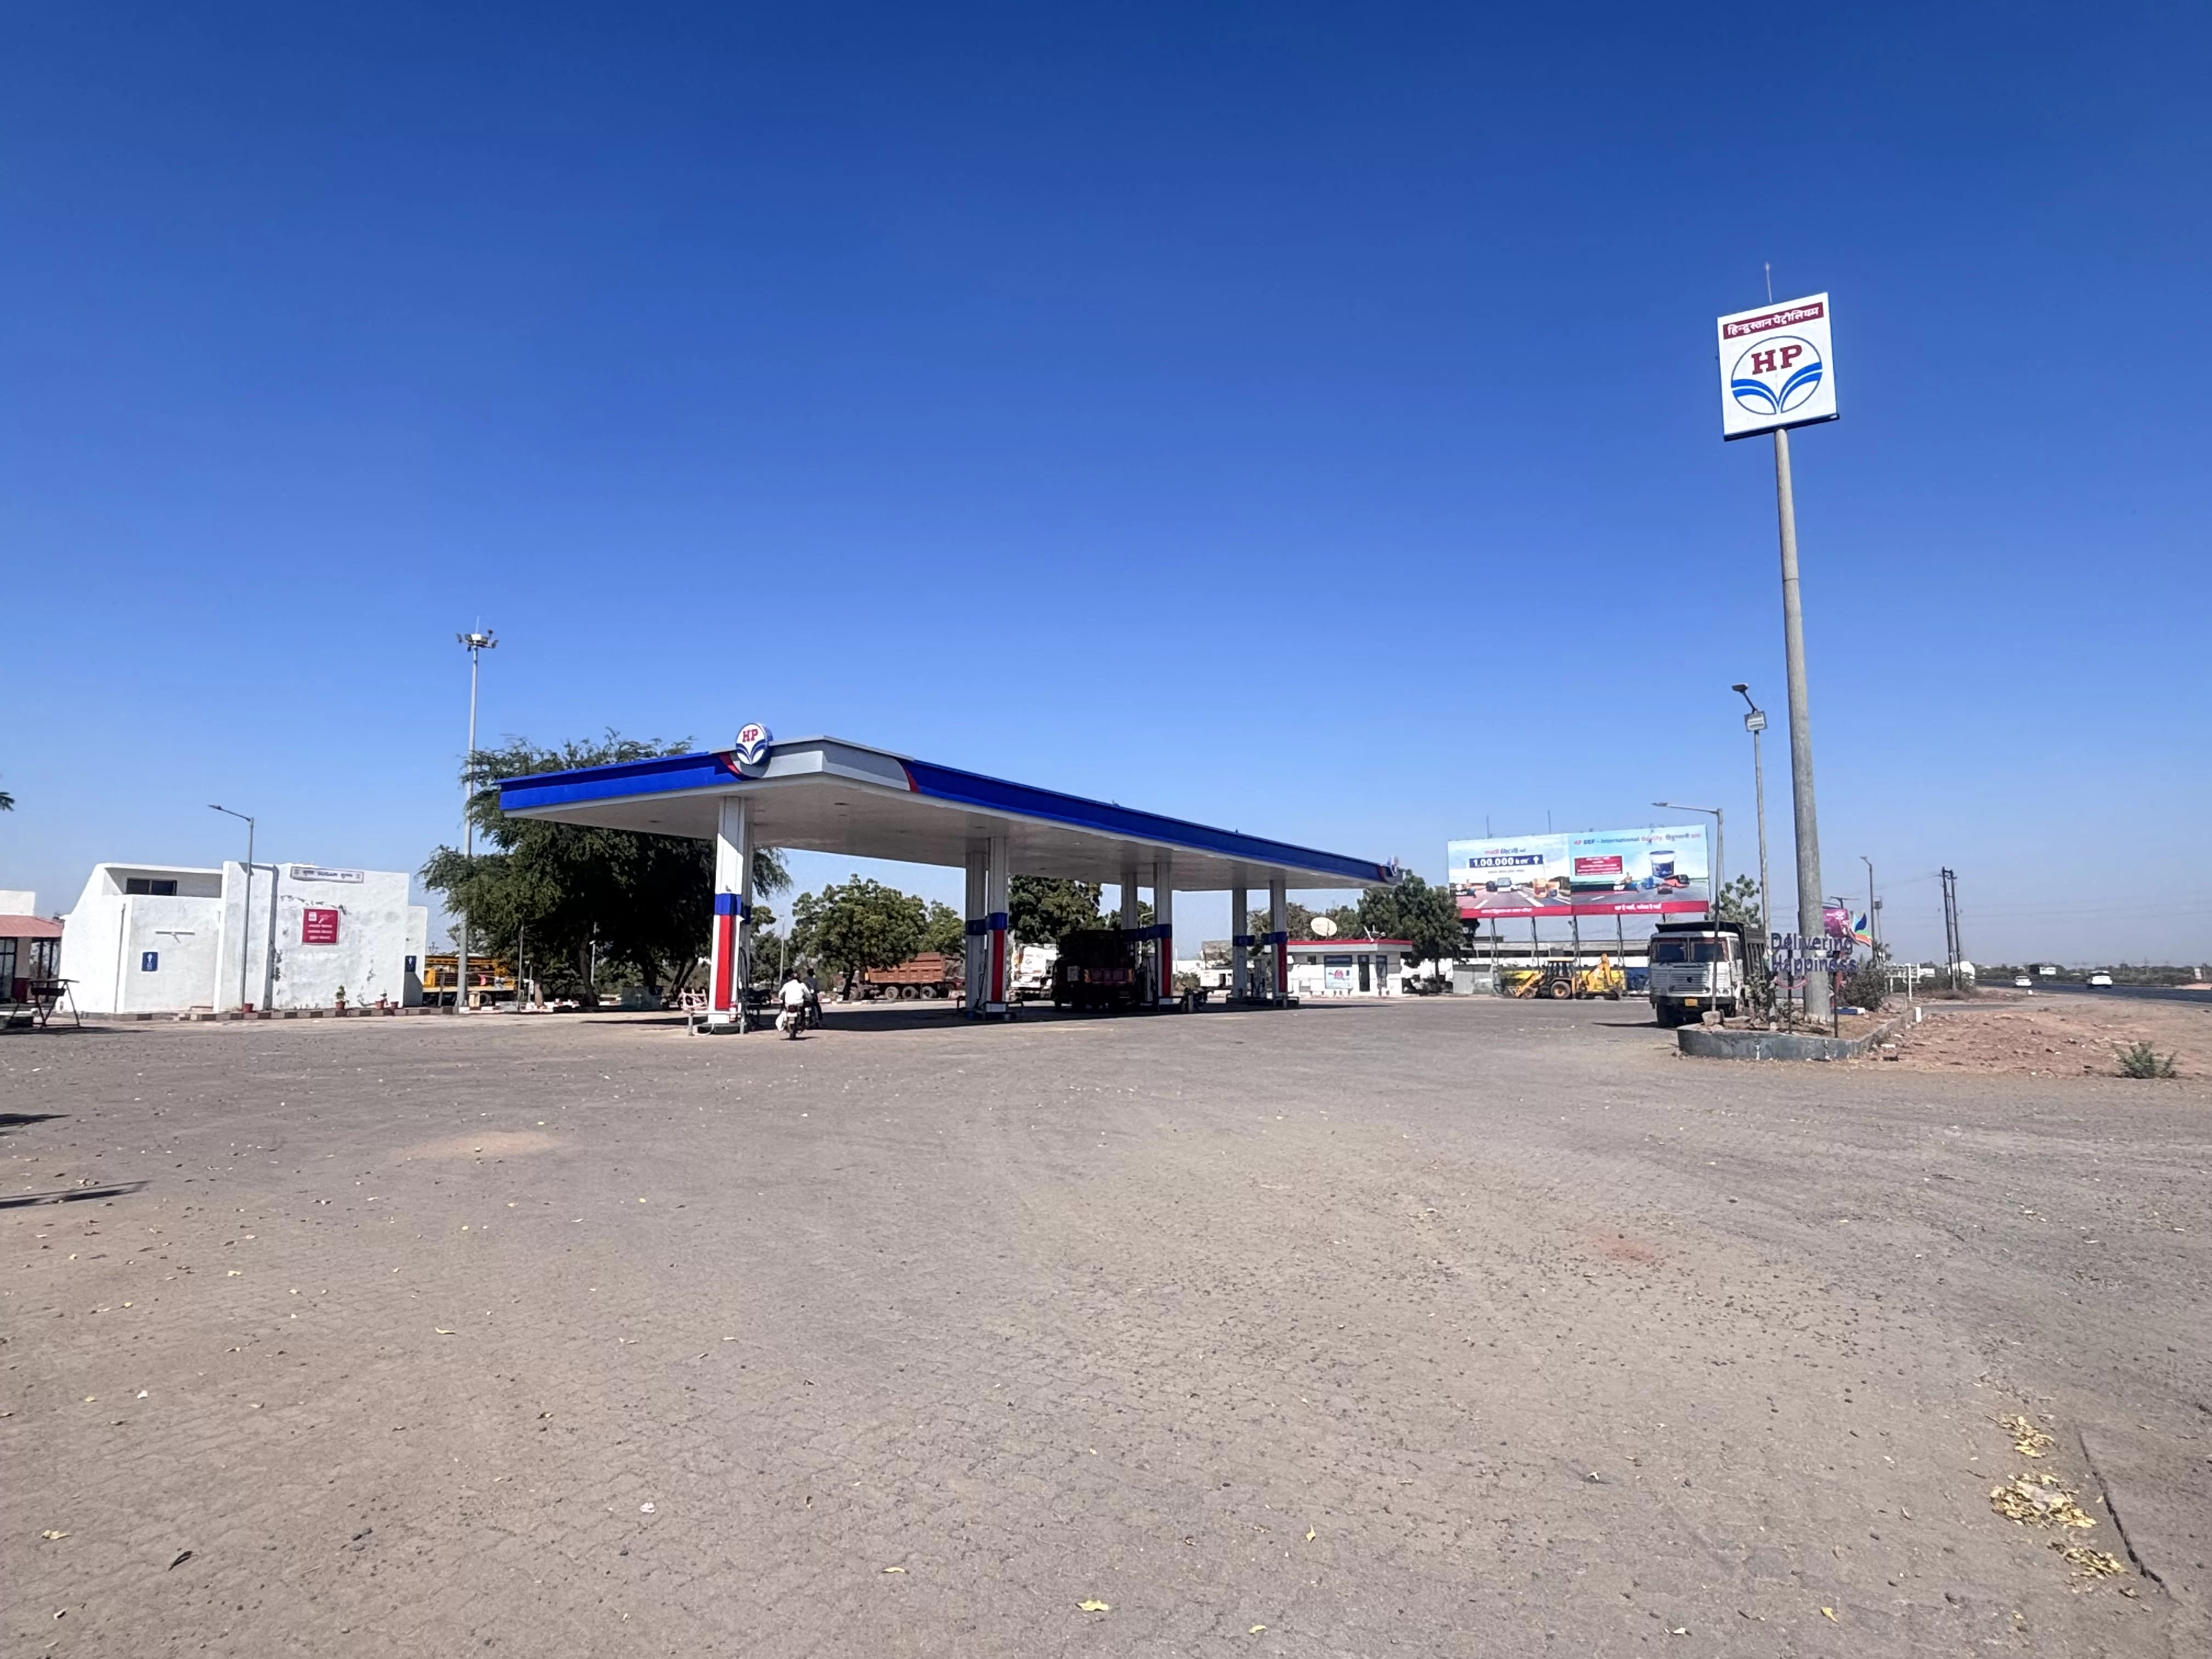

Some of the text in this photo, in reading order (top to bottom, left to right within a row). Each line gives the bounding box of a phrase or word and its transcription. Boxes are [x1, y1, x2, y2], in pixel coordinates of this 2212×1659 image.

[1751, 345, 1802, 375] HP
[742, 729, 758, 742] HP
[1771, 933, 1853, 955] Delivering
[1771, 954, 1858, 975] Happiness
